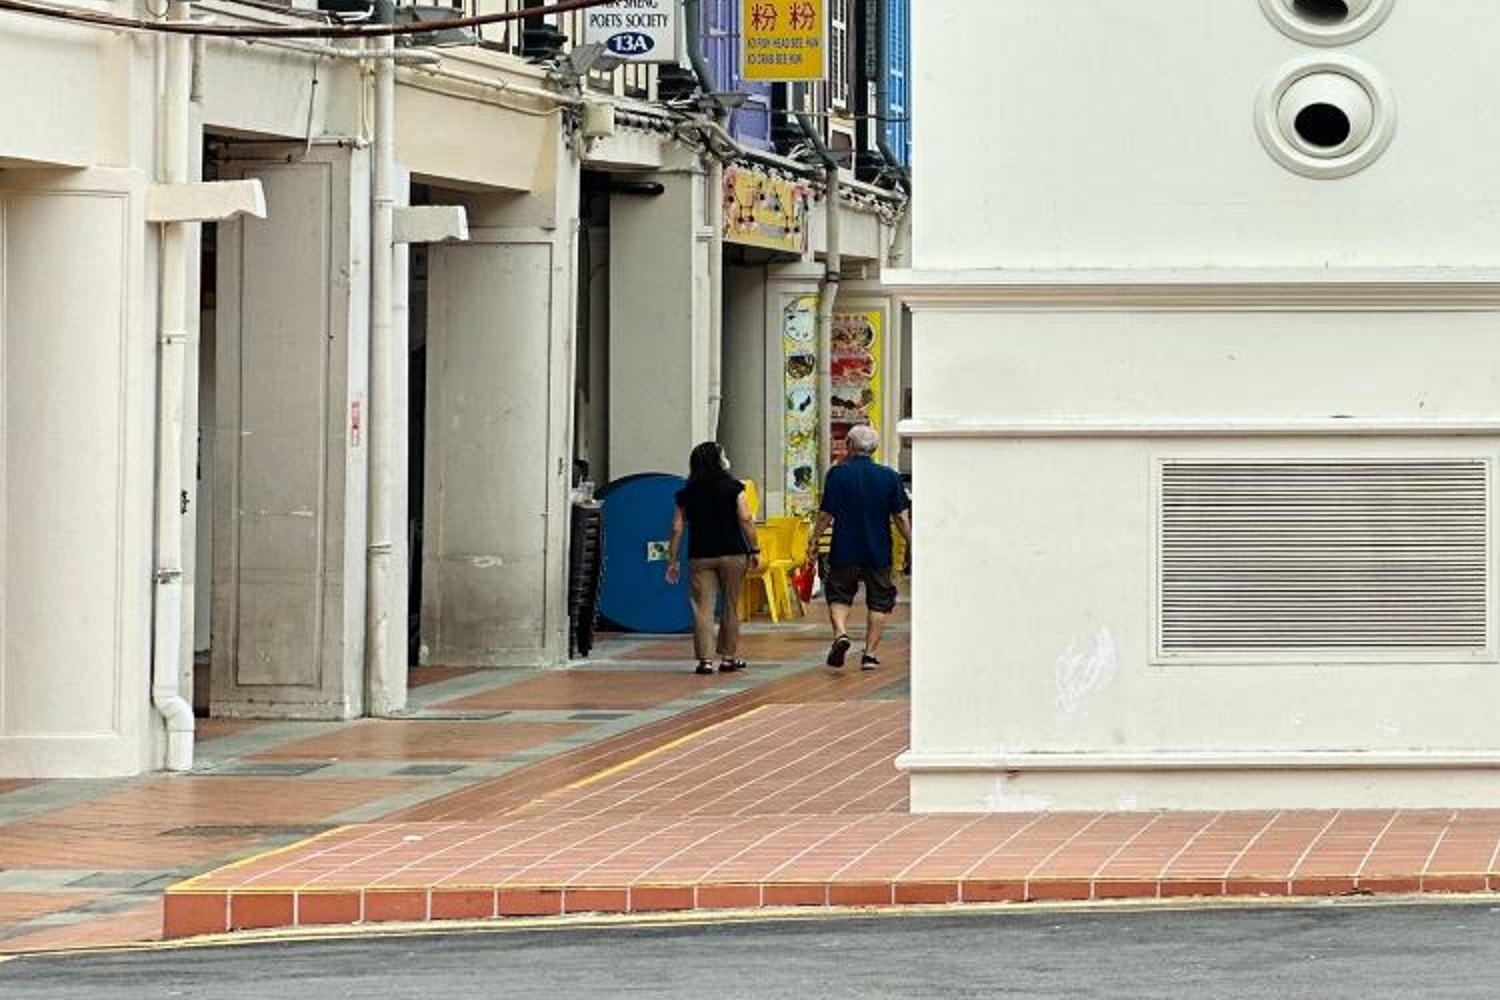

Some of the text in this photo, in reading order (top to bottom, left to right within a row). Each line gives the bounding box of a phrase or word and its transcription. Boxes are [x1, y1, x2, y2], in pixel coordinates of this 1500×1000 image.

[590, 13, 669, 28] POETS SOCIETY
[612, 35, 648, 51] 13A
